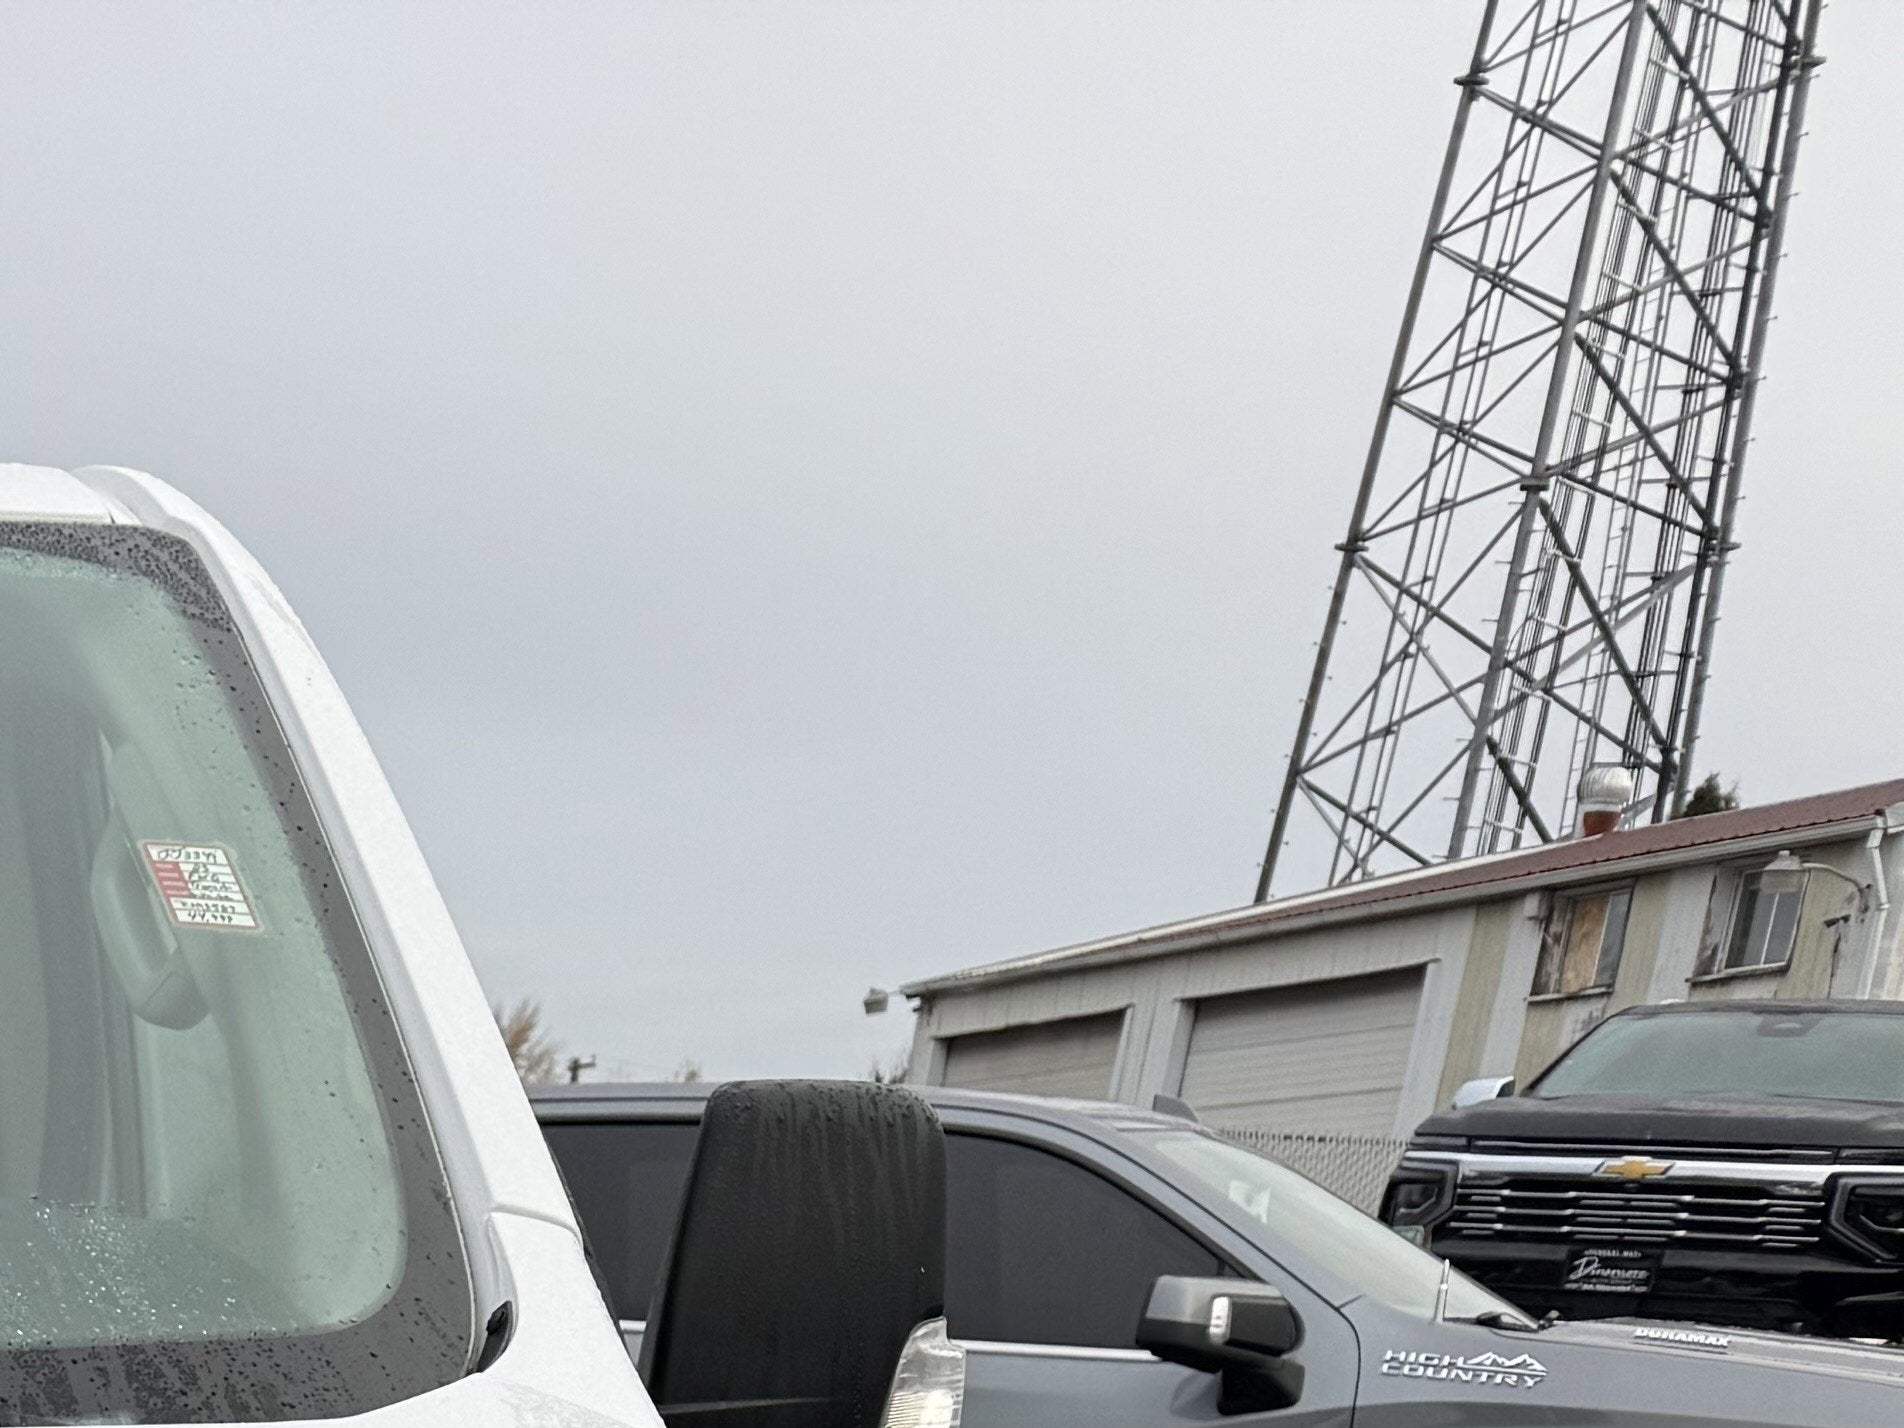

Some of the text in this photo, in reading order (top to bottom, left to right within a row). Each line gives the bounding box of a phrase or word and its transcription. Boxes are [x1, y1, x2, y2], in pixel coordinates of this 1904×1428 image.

[1634, 1327, 1729, 1347] DURAMAX
[1384, 1350, 1465, 1367] HIGH
[1381, 1362, 1543, 1388] COUNTRY
